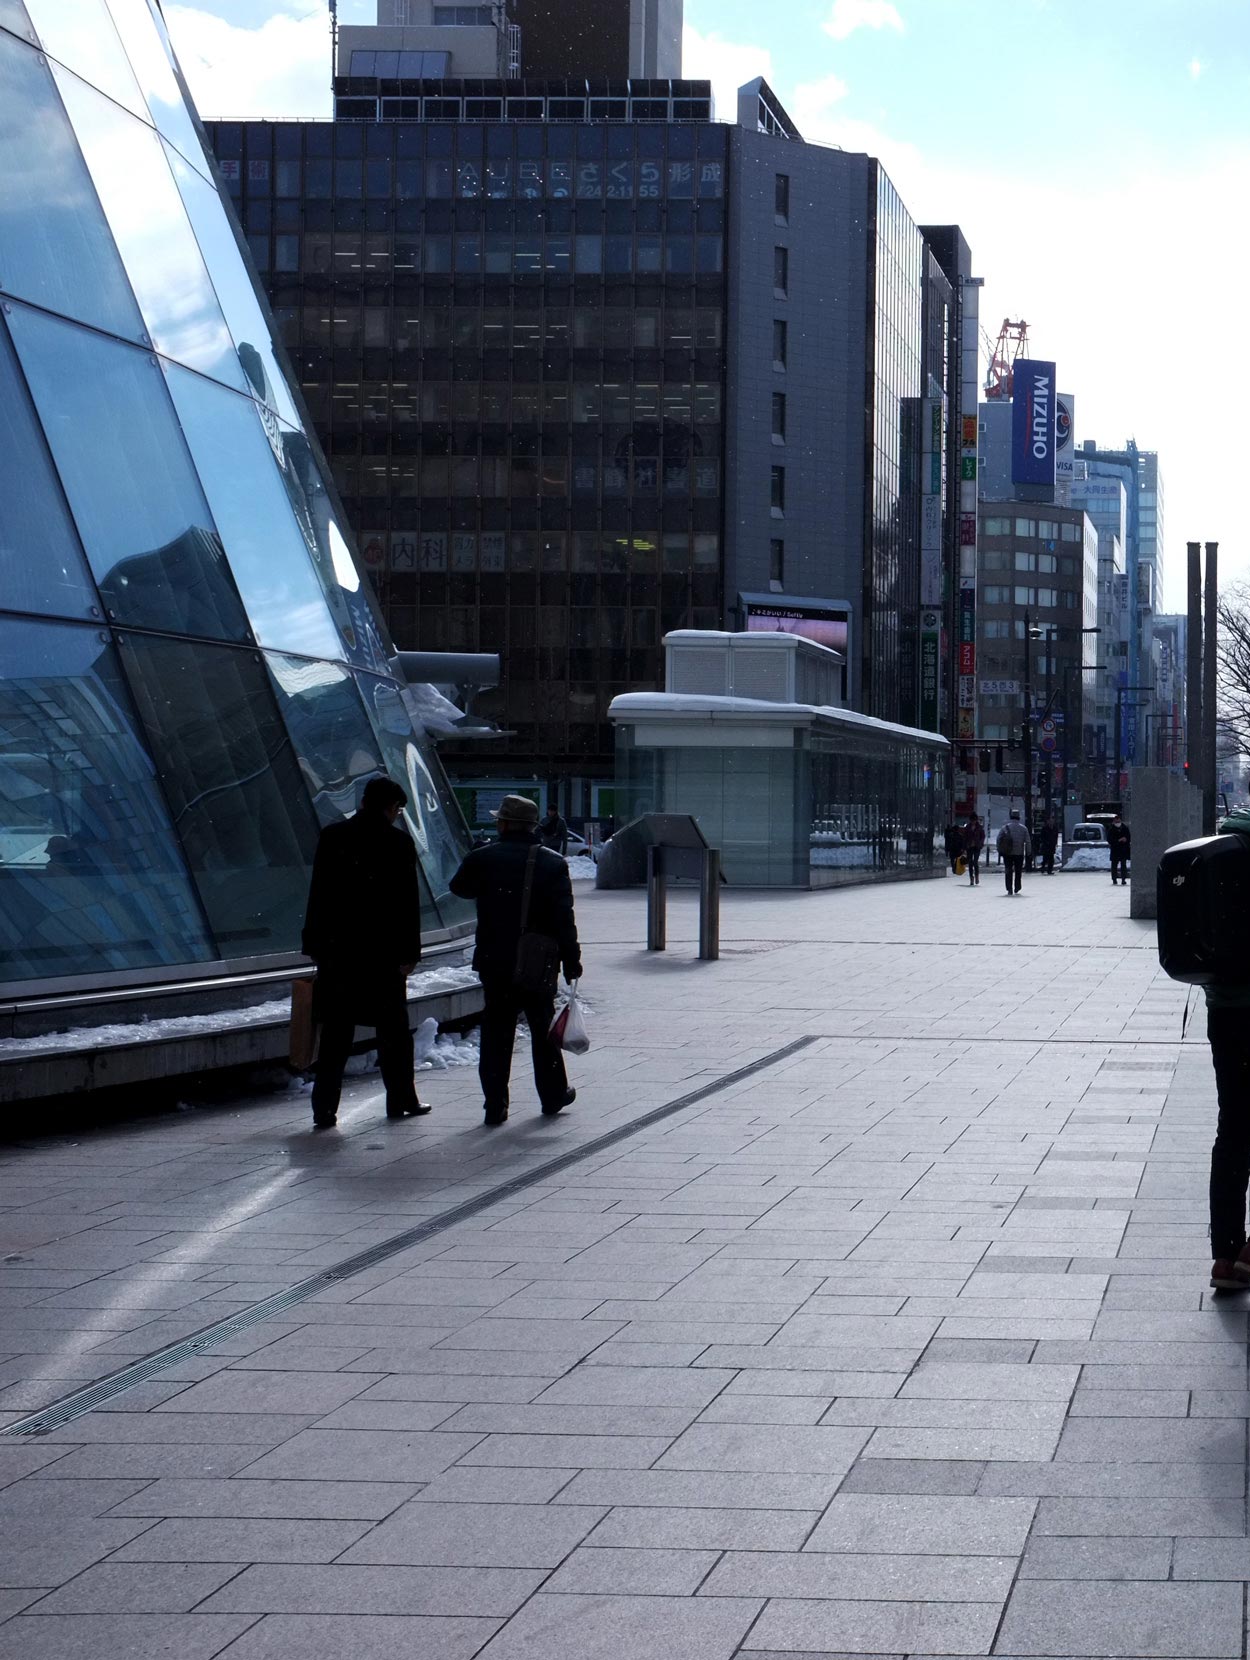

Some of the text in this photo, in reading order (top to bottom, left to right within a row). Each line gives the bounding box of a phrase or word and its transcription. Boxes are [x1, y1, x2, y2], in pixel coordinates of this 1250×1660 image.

[1033, 375, 1049, 459] MIZUHO
[1057, 462, 1073, 471] VISA
[393, 538, 446, 568] 内科
[963, 645, 971, 665] アコム
[923, 641, 936, 701] 北海道銀行
